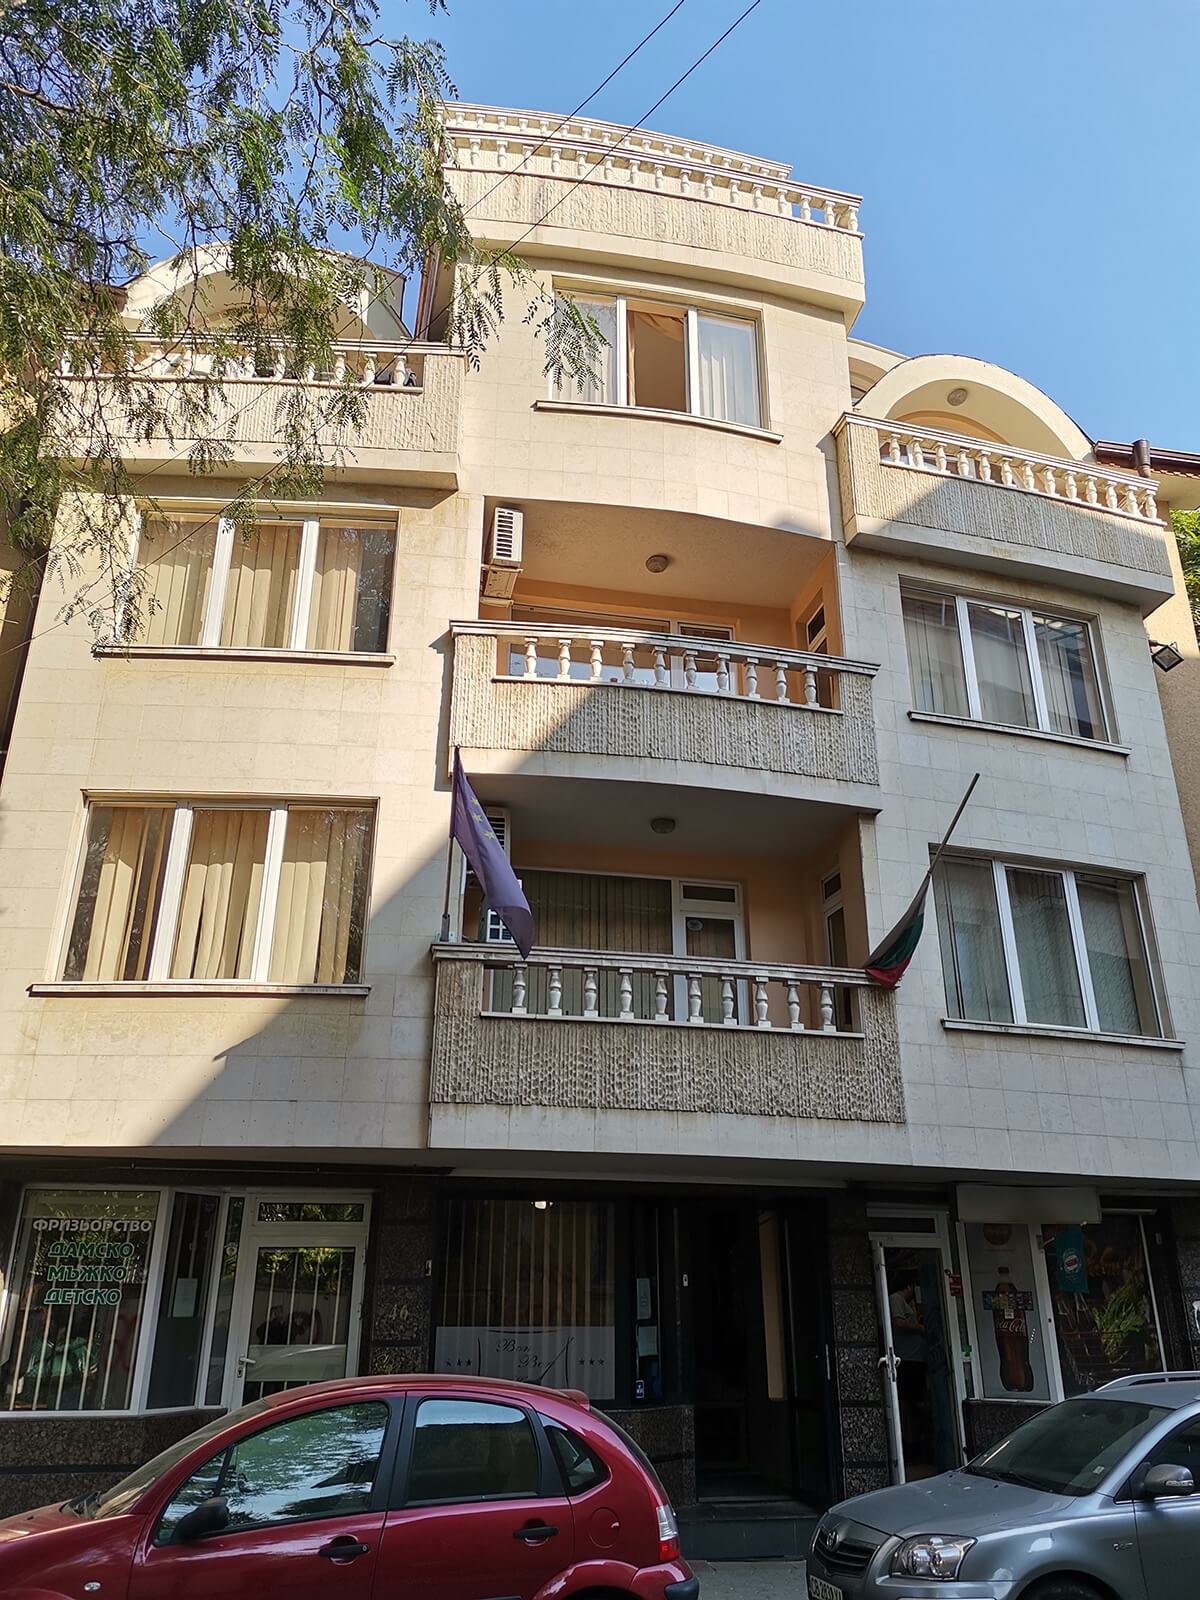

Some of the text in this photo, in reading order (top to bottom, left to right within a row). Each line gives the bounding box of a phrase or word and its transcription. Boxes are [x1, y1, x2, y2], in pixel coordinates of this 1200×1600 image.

[33, 1219, 152, 1232] ФРИЗЬОРСТВО
[48, 1241, 135, 1258] ДАМСКО
[47, 1264, 128, 1282] МЪЖКО
[44, 1287, 122, 1305] ДЕТСКО
